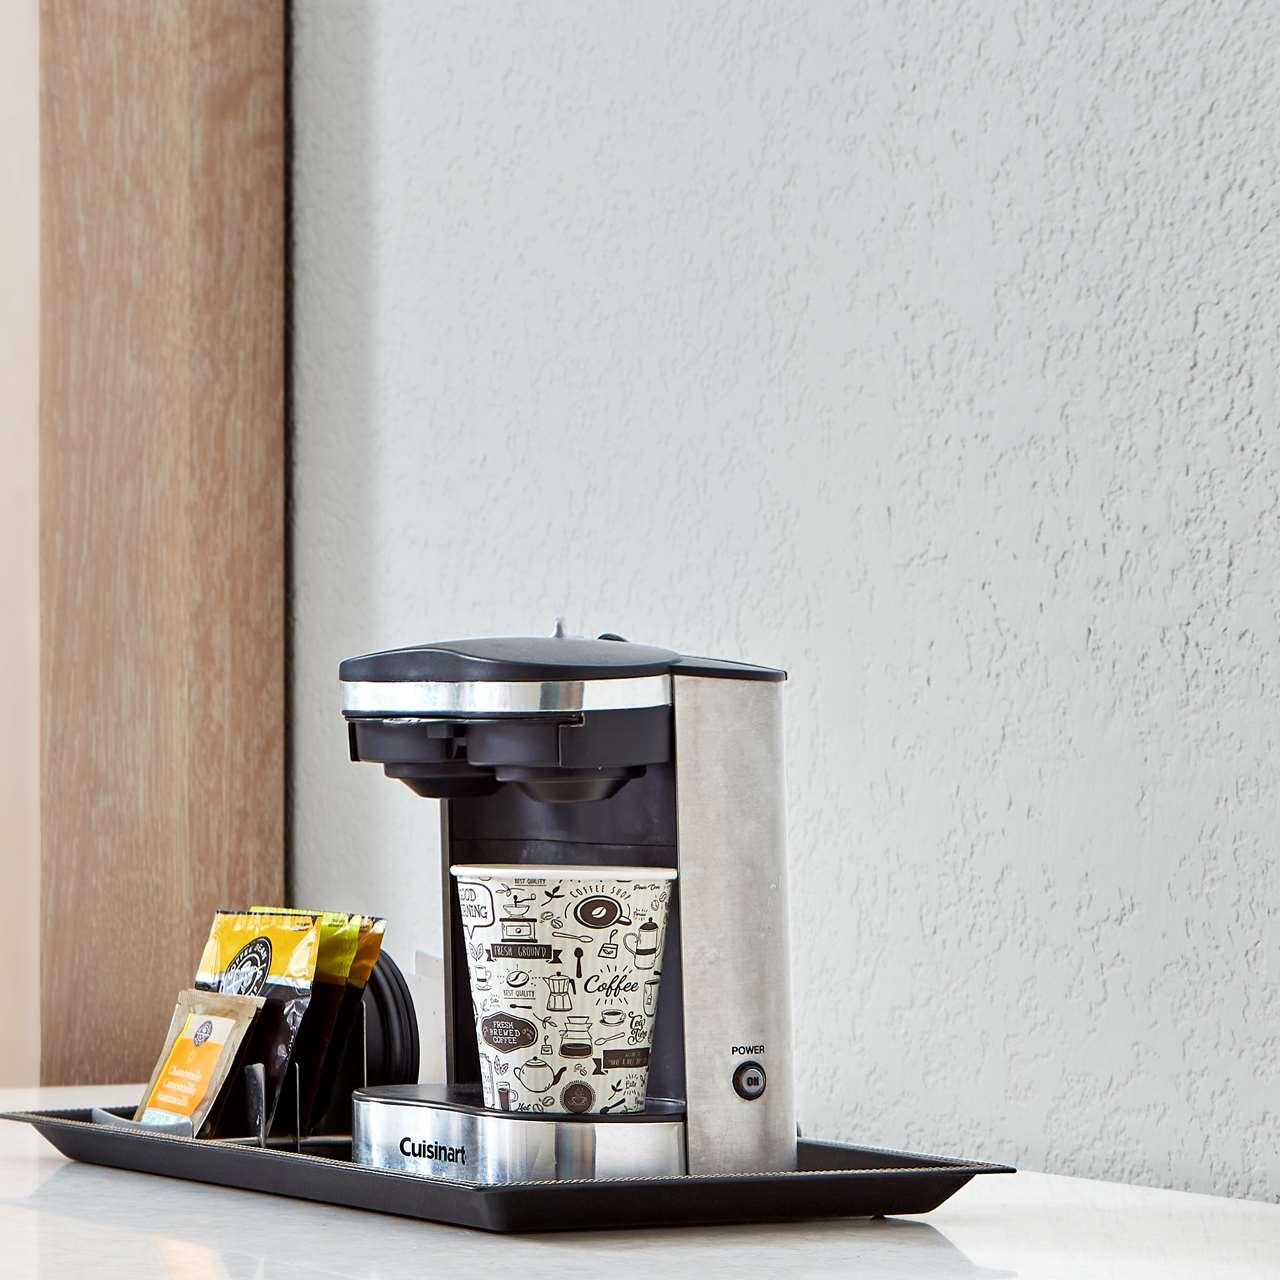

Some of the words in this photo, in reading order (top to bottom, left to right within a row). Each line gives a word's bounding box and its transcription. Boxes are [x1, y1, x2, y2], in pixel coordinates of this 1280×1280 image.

[569, 885, 605, 898] COFFEE
[494, 946, 512, 957] FRESH
[517, 946, 546, 957] GROUND
[584, 975, 639, 997] Coffee
[515, 990, 535, 998] QUALITY
[492, 1020, 514, 1030] FRESH
[489, 1028, 521, 1038] BREWED
[492, 1036, 518, 1045] COFFEE
[731, 1045, 765, 1055] POWER
[746, 1076, 760, 1087] ON
[399, 1136, 466, 1165] Cuisinart
